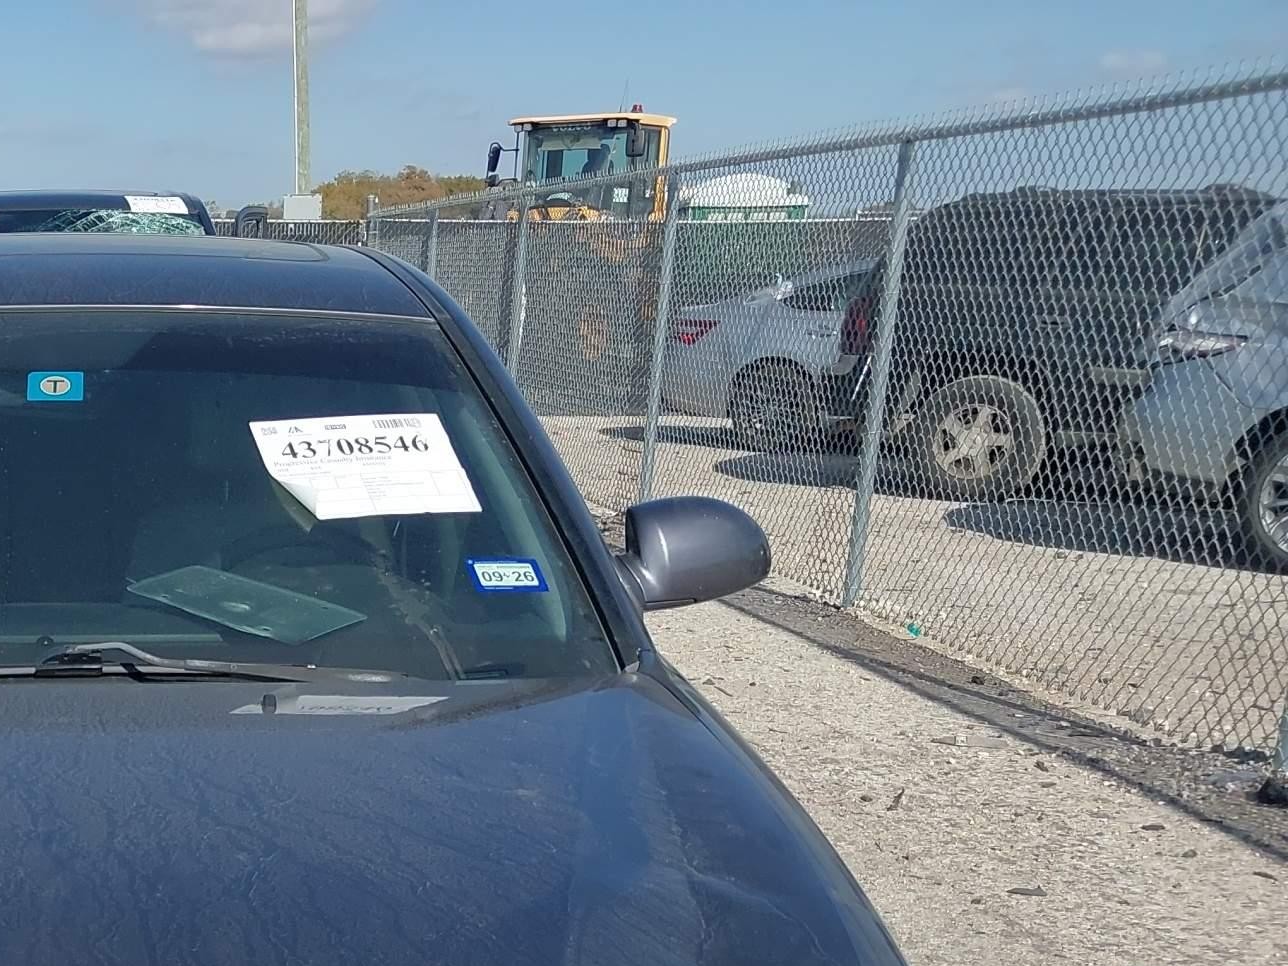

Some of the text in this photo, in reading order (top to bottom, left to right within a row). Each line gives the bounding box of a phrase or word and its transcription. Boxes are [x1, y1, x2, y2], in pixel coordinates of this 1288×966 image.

[46, 379, 65, 394] T
[281, 432, 430, 459] 43708546
[481, 570, 535, 582] 09 26
